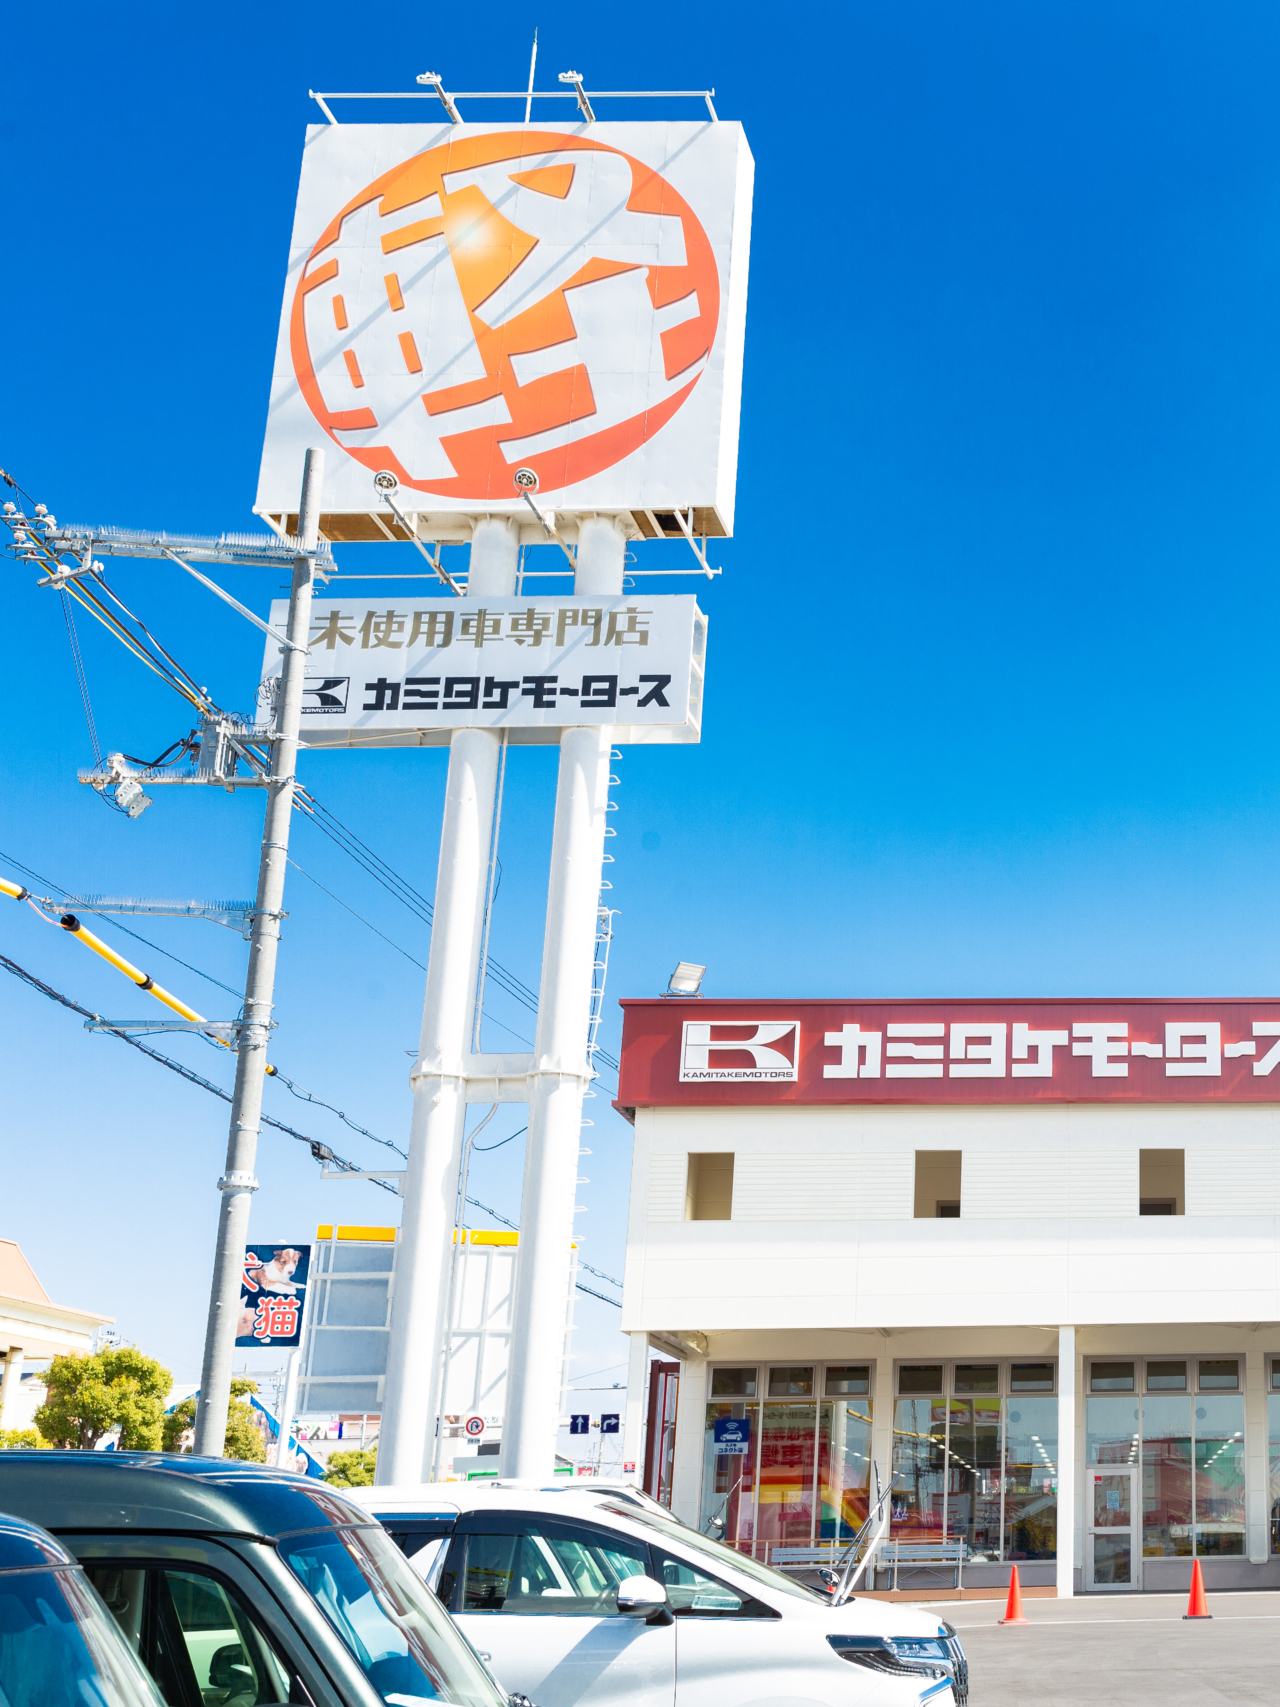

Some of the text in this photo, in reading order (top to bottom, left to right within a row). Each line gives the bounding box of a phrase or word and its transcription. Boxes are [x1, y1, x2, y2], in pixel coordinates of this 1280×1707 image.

[307, 607, 653, 651] 未使用車専門店
[363, 675, 672, 711] カミタケモータース
[254, 1297, 300, 1337] 猫
